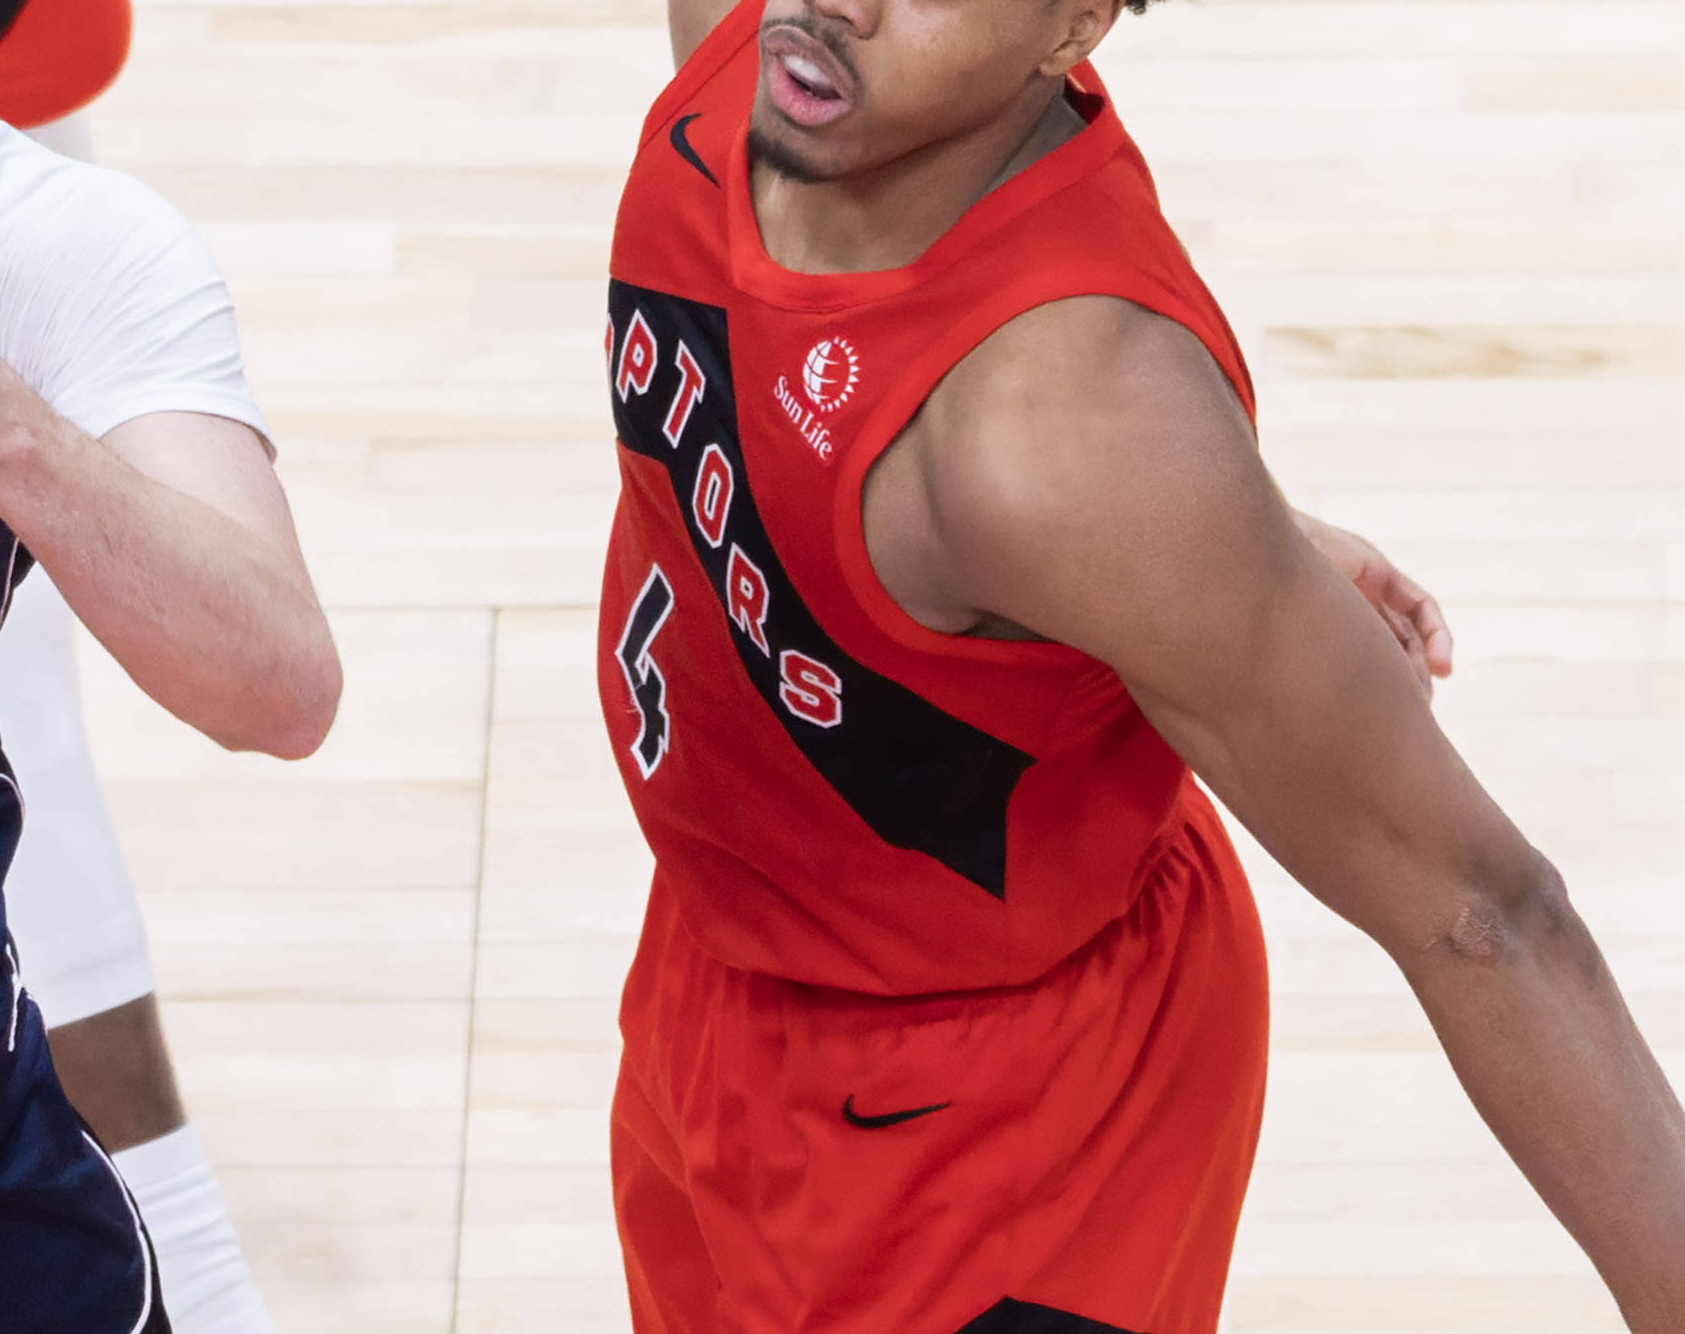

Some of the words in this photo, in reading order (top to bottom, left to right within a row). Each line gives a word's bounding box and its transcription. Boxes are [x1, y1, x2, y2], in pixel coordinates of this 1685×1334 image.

[604, 308, 842, 729] PTORS
[773, 375, 803, 424] Sun
[800, 411, 833, 460] Life
